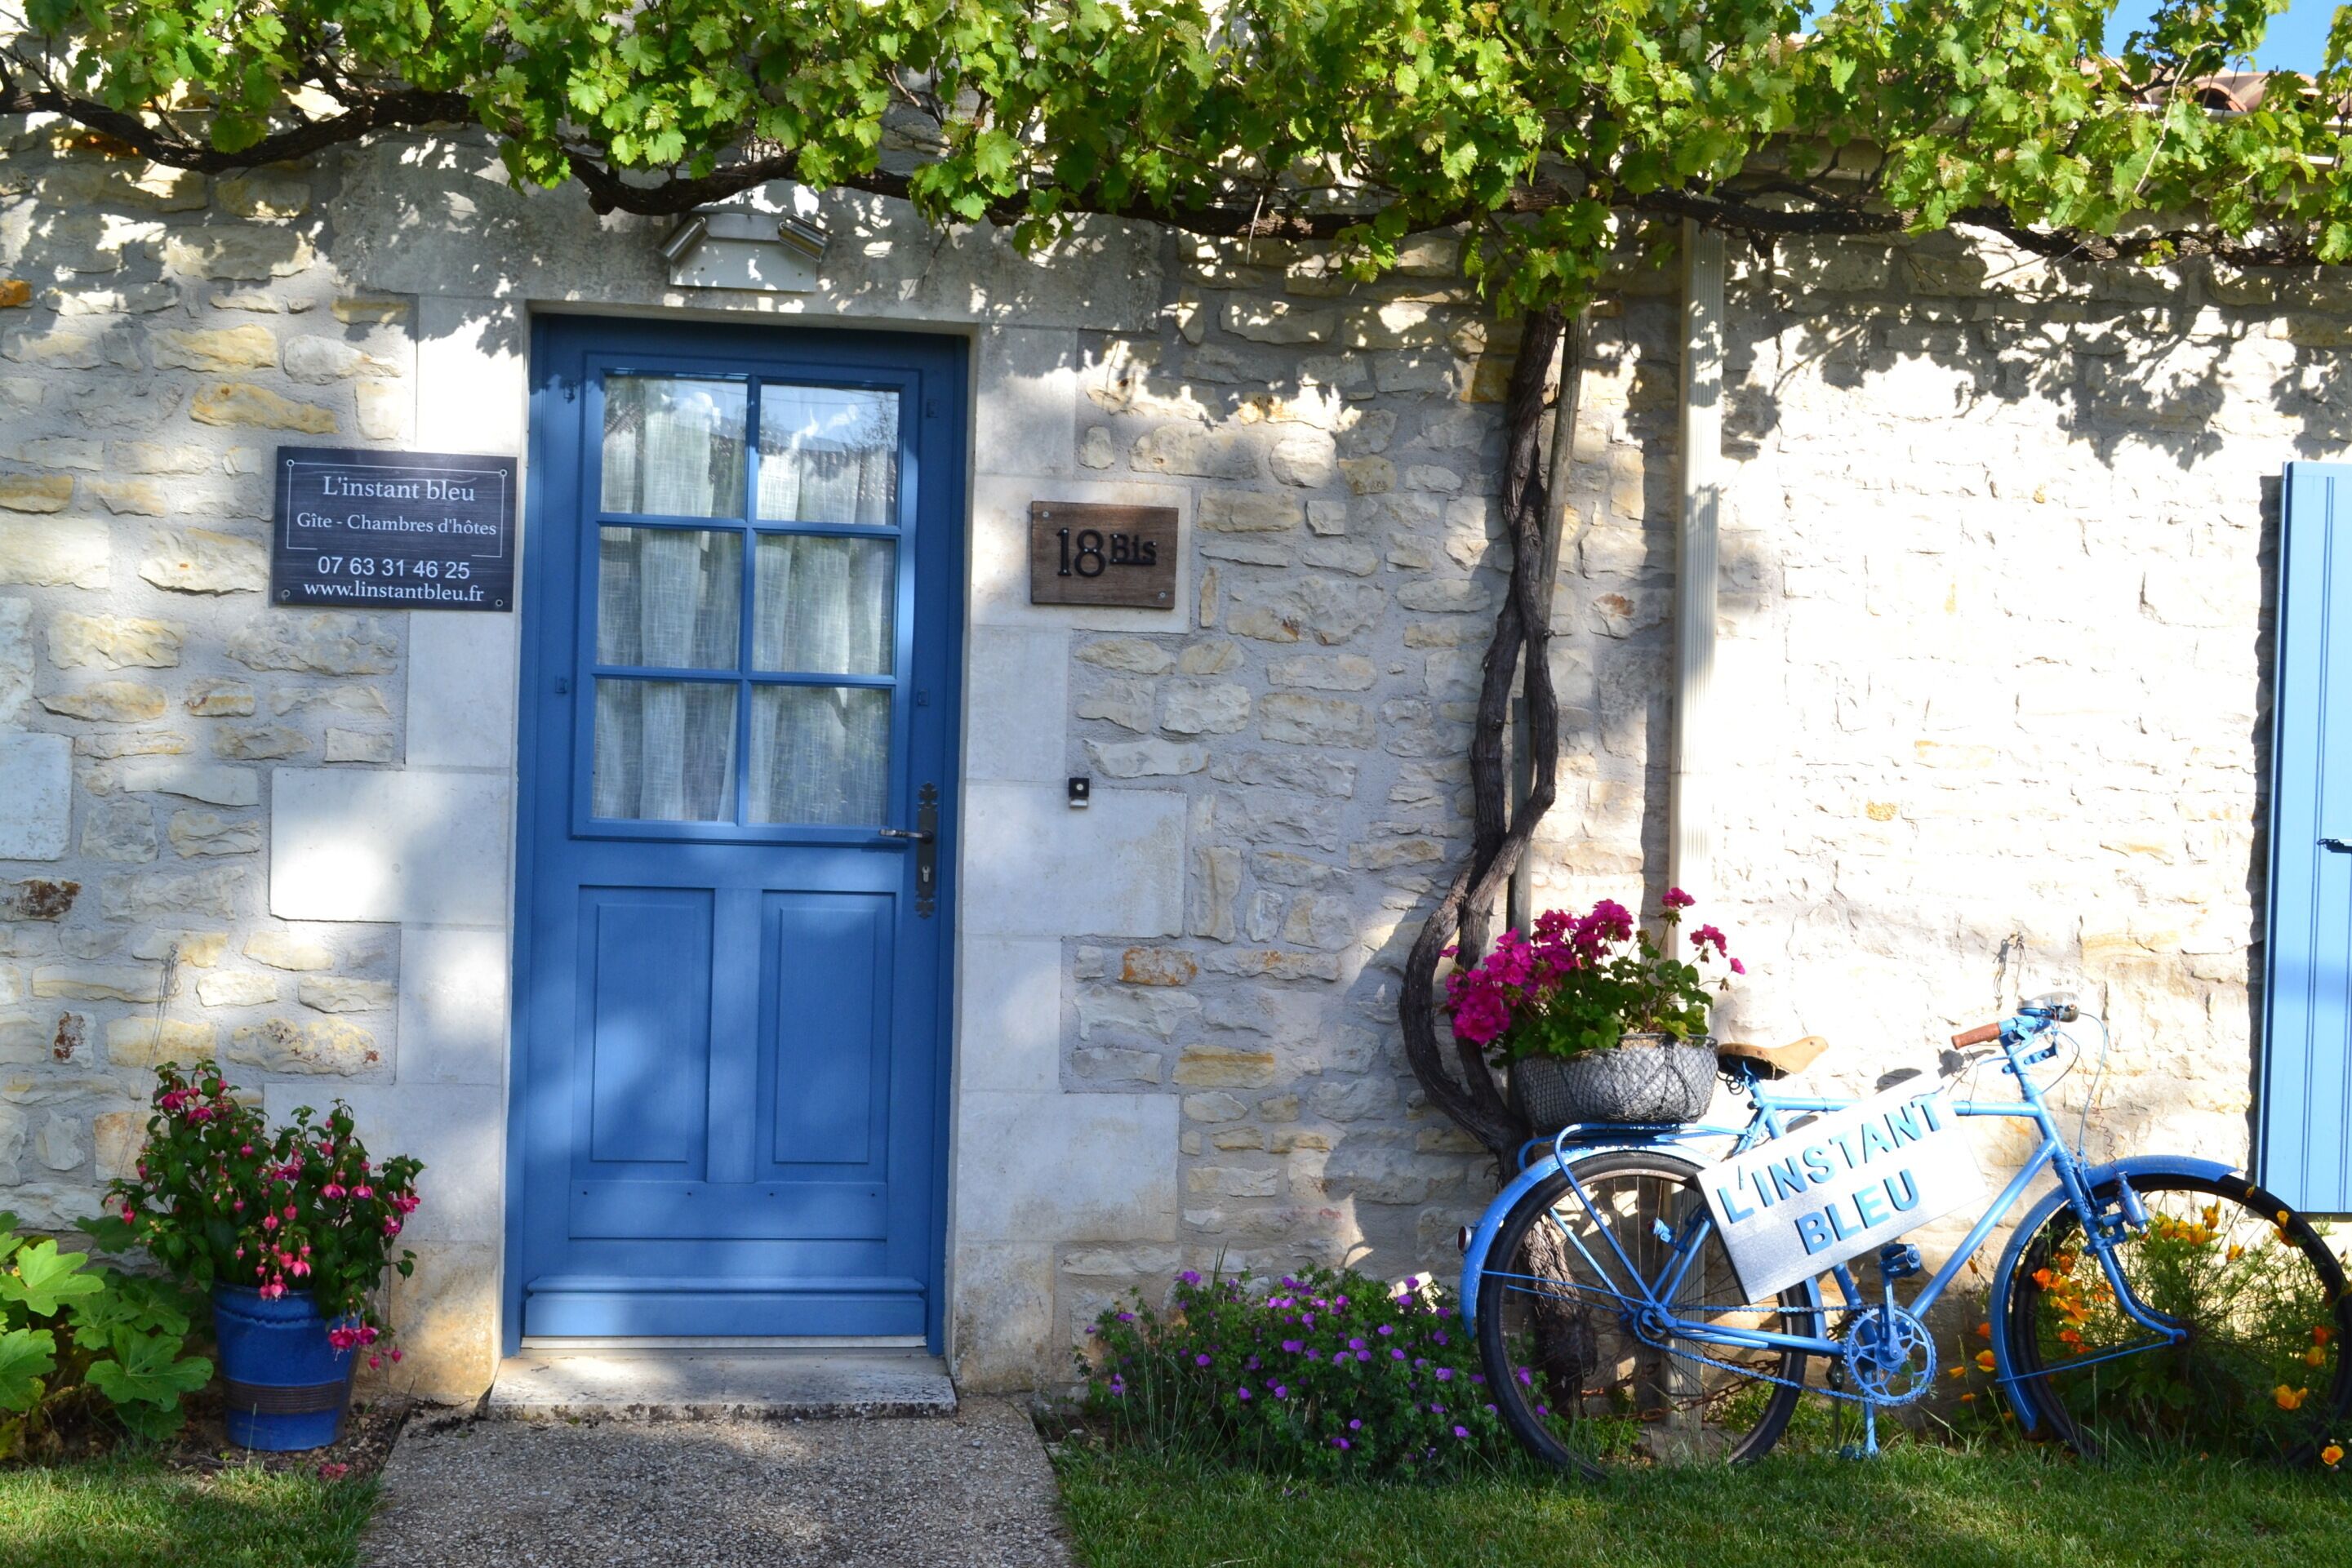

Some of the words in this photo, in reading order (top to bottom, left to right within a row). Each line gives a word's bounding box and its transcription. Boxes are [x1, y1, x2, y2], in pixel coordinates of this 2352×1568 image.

[322, 475, 420, 499] L'instant
[426, 479, 476, 502] bleu
[296, 512, 332, 528] Gîte
[347, 513, 433, 532] Chambres
[438, 517, 497, 535] d'hôtes
[1056, 527, 1106, 577] 18
[318, 556, 343, 574] 07
[349, 557, 375, 575] 63
[381, 558, 404, 577] 31
[413, 560, 438, 578] 46
[445, 562, 470, 580] 25
[304, 580, 484, 602] www.linstantbleu.fr
[1717, 1093, 1941, 1224] L'INSTANT
[1794, 1168, 1920, 1255] BLEU
